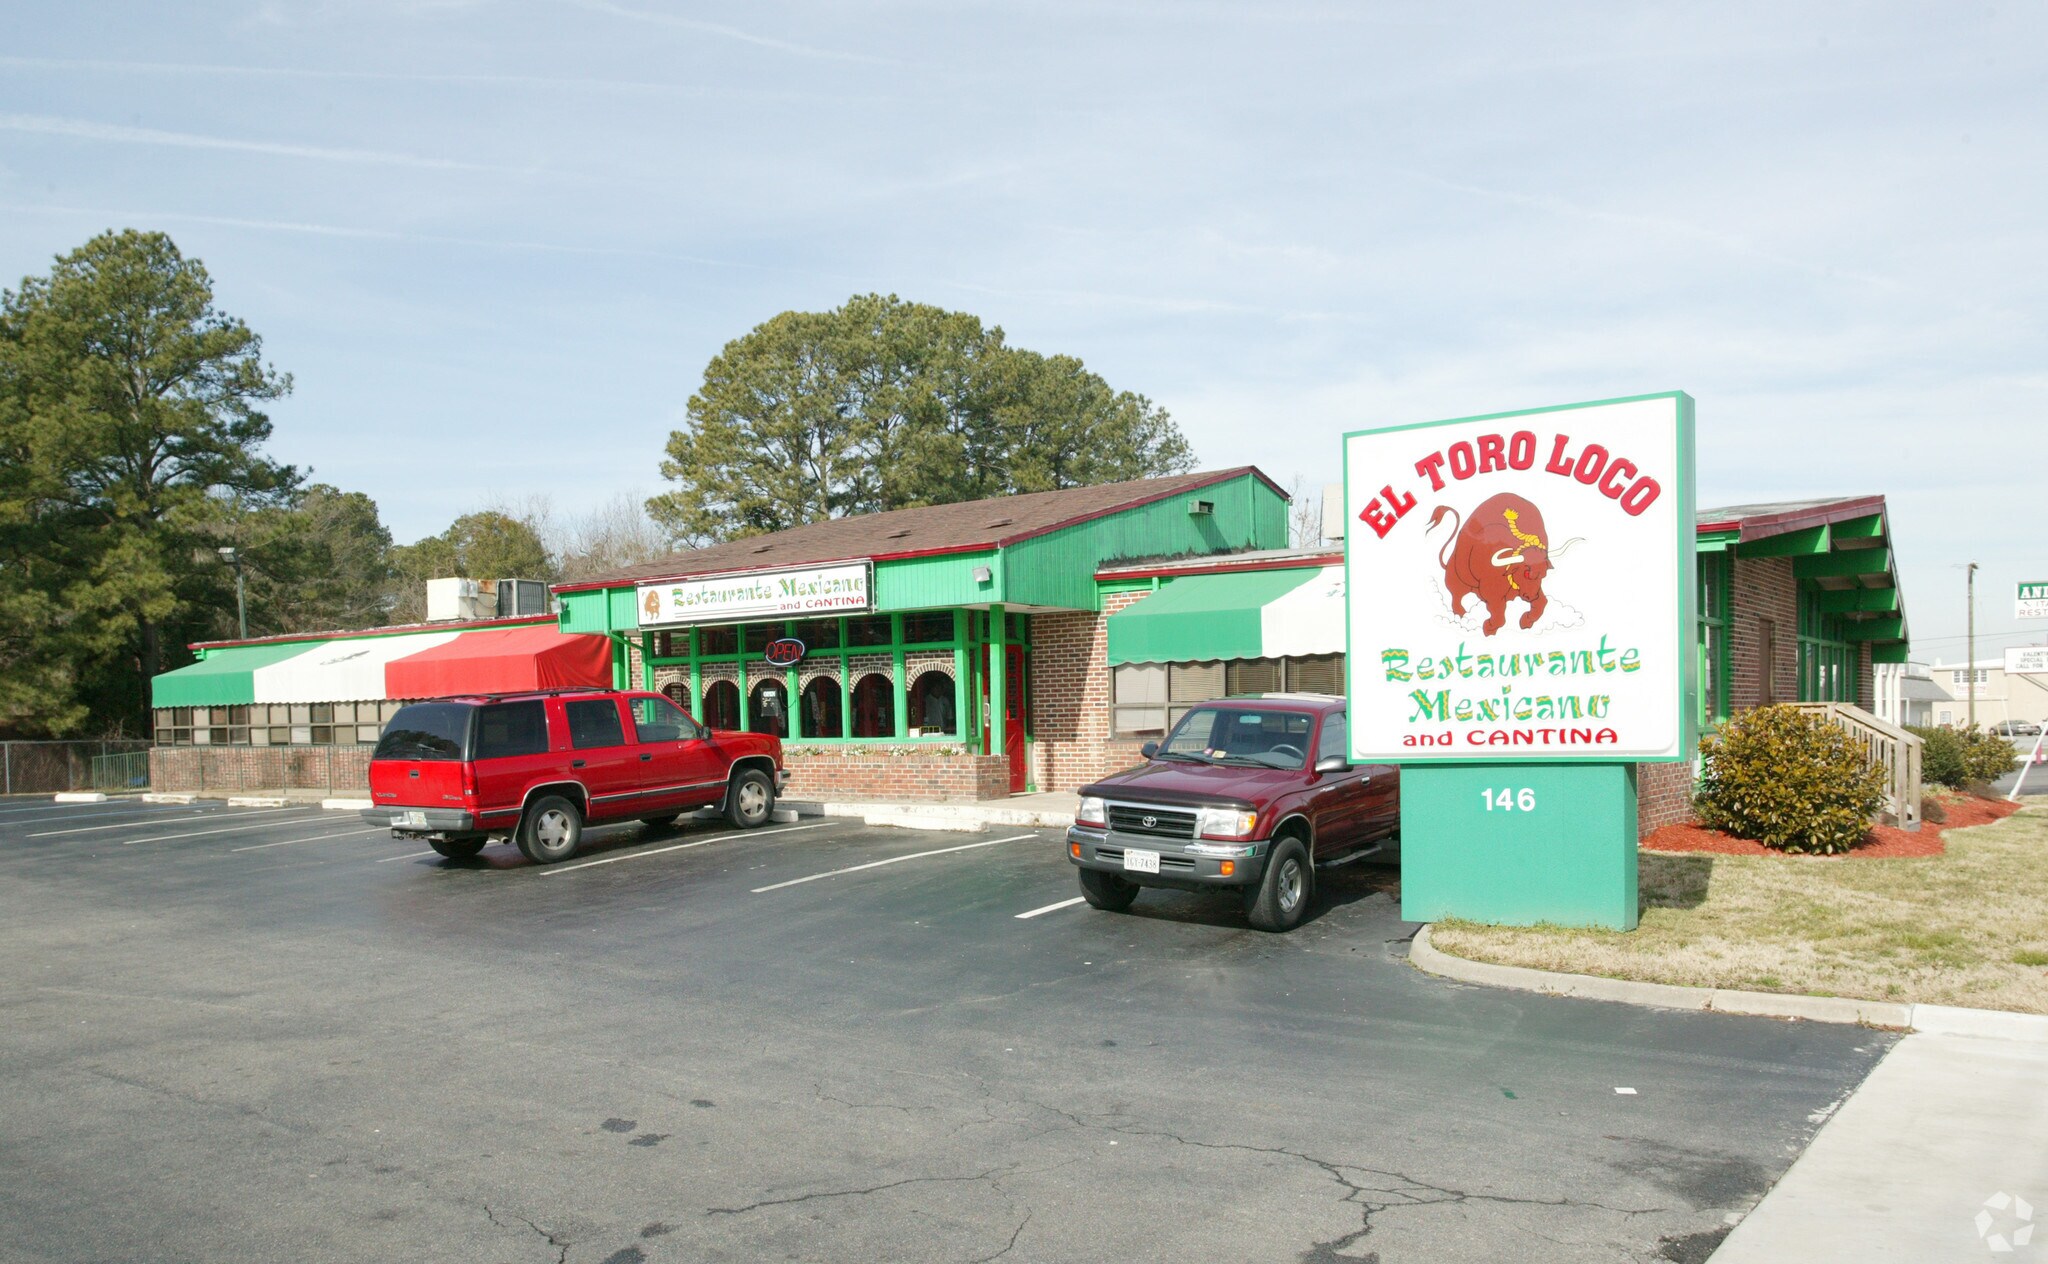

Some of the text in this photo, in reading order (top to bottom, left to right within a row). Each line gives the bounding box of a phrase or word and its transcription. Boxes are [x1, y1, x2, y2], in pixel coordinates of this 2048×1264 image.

[1358, 430, 1661, 539] EL TORO LOCO
[672, 574, 864, 607] Restaurante Mexicano
[780, 595, 865, 611] and CANTINA
[766, 641, 802, 661] OPEN
[1381, 634, 1641, 682] Restaurante
[1408, 684, 1610, 723] Mexicano
[1402, 727, 1618, 747] and CANTINA
[1481, 787, 1536, 812] 146
